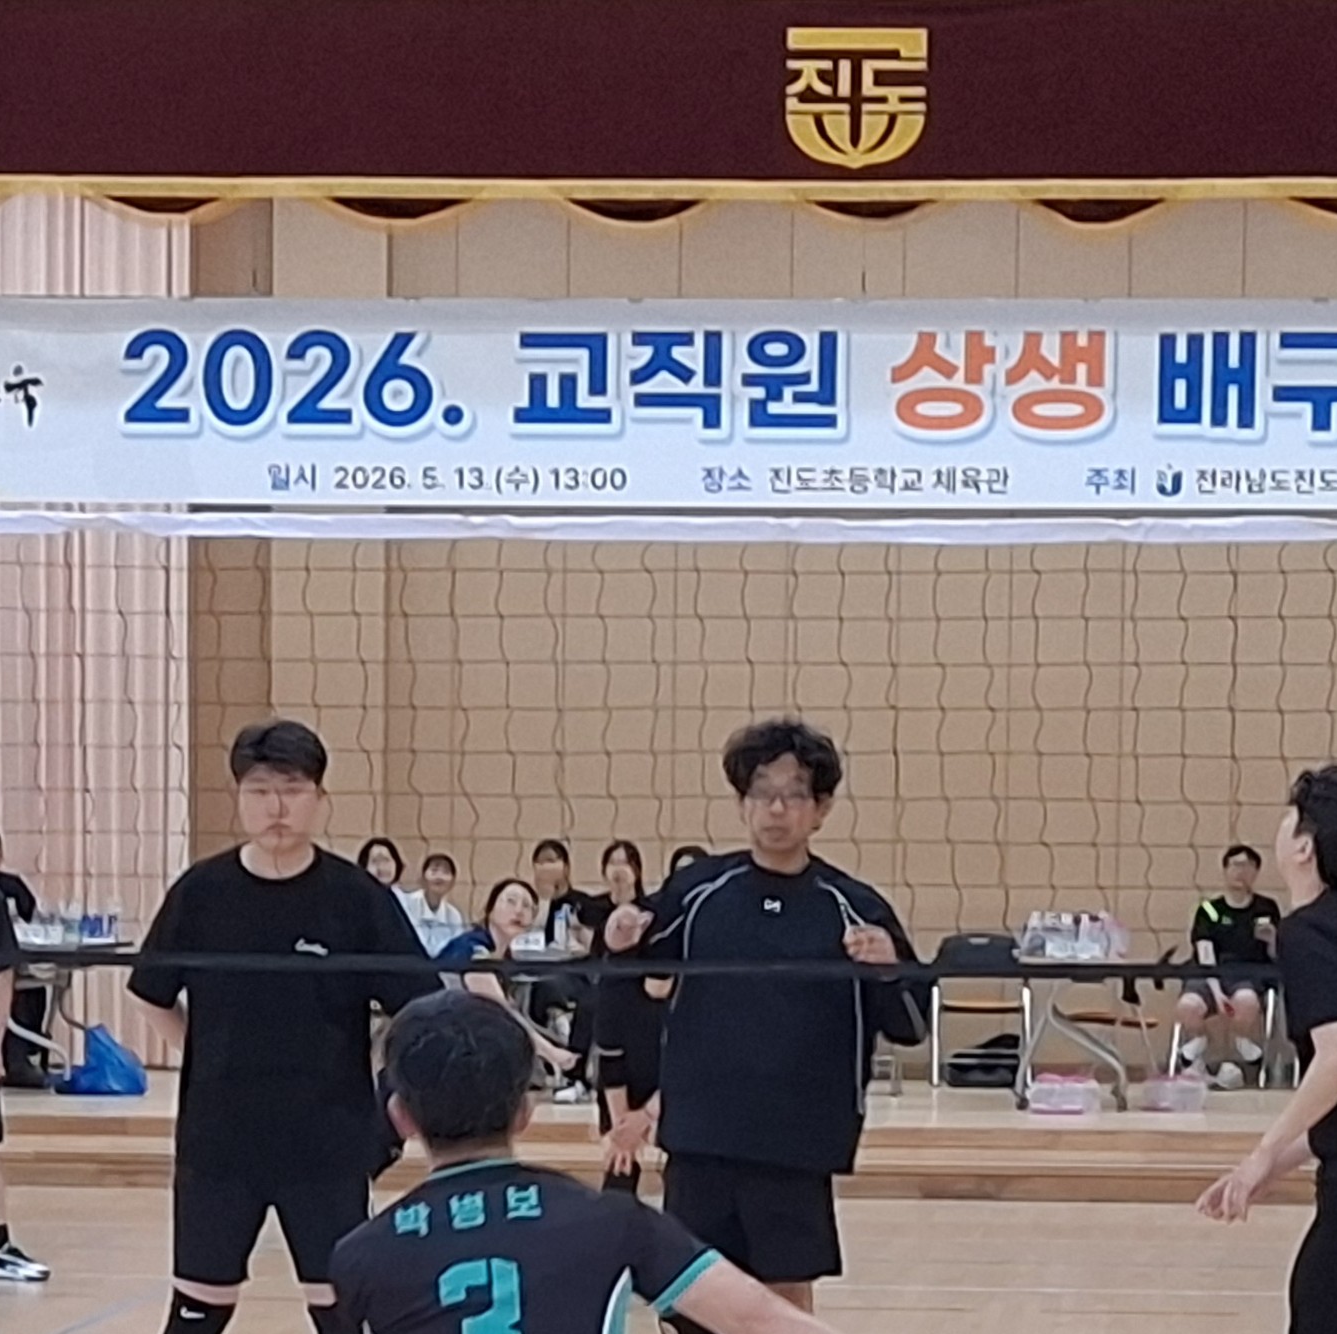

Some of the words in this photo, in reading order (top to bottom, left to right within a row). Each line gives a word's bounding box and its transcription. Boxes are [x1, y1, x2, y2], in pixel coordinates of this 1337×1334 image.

[123, 328, 464, 428] 2026.
[513, 330, 838, 429] 교직원
[891, 329, 1106, 430] 상생
[268, 464, 317, 492] 일시
[333, 466, 413, 491] 2026.
[550, 466, 628, 491] 13:00
[701, 466, 752, 494] 장소
[769, 466, 923, 494] 진도초등학교
[932, 466, 1009, 494] 체육관
[1085, 466, 1136, 495] 주최
